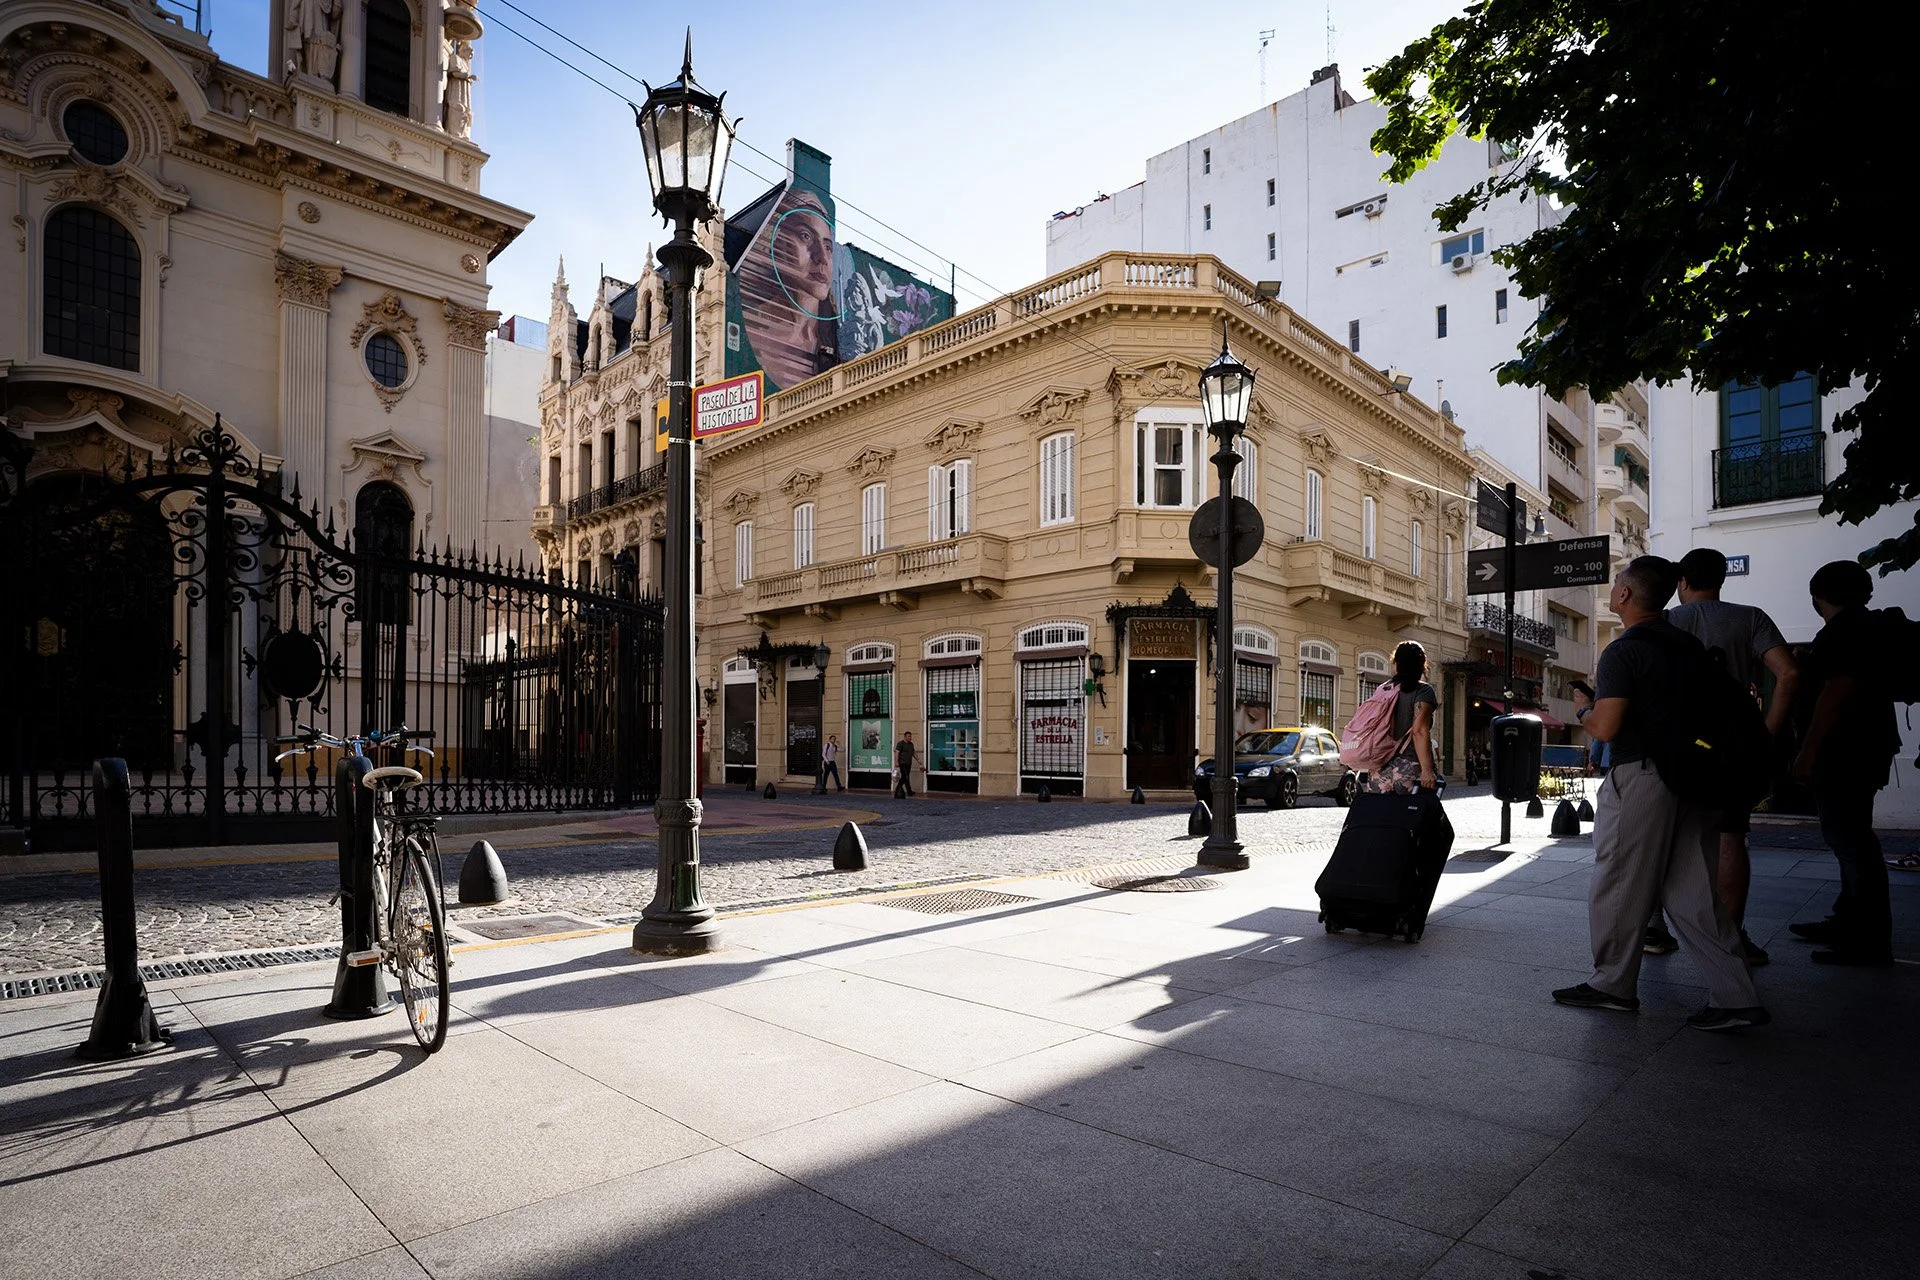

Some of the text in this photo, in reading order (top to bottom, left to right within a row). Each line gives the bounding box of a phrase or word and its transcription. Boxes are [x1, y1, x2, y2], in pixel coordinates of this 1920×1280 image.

[702, 385, 755, 411] PASEO DE LA
[702, 405, 754, 430] HISTORIETA
[1559, 540, 1603, 552] Defensa
[1553, 564, 1573, 575] 200
[1584, 562, 1603, 572] 100
[1567, 575, 1597, 583] Comuna
[1133, 620, 1190, 634] FARMACIA
[1139, 635, 1185, 643] ESTRELLA
[1134, 646, 1191, 655] HOMEOP
[1031, 716, 1077, 729] FARMACIA
[1035, 735, 1073, 744] ESTRELLA
